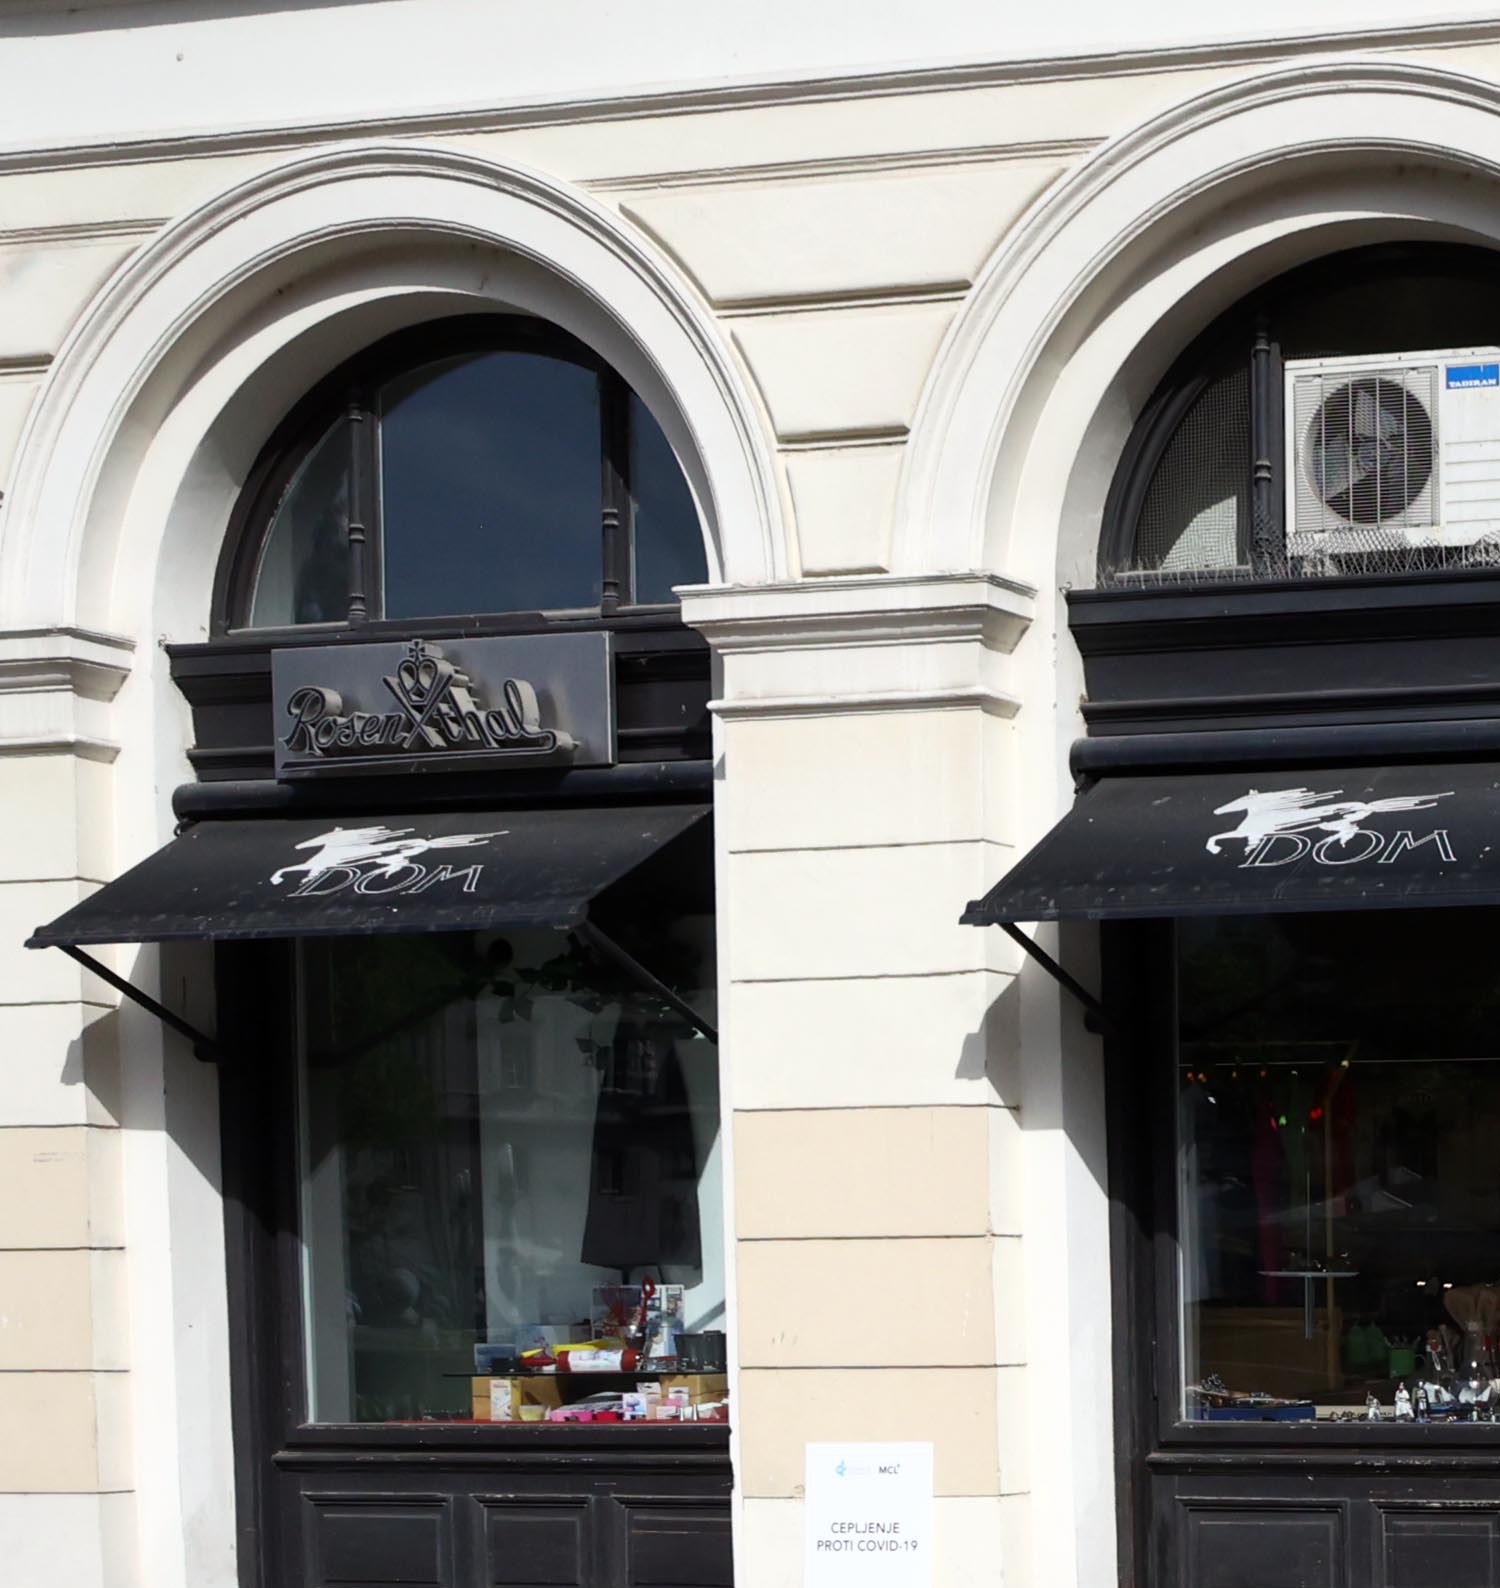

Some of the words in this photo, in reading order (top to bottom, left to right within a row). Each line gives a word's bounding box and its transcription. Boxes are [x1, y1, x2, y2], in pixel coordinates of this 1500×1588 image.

[1448, 378, 1497, 389] TADIRAN
[278, 674, 558, 759] Rosenthal
[1238, 829, 1458, 868] DOM
[286, 863, 485, 898] DOM
[830, 1522, 900, 1534] CEPLJENJE
[816, 1540, 853, 1552] PROTI
[857, 1540, 919, 1552] COVID-19
